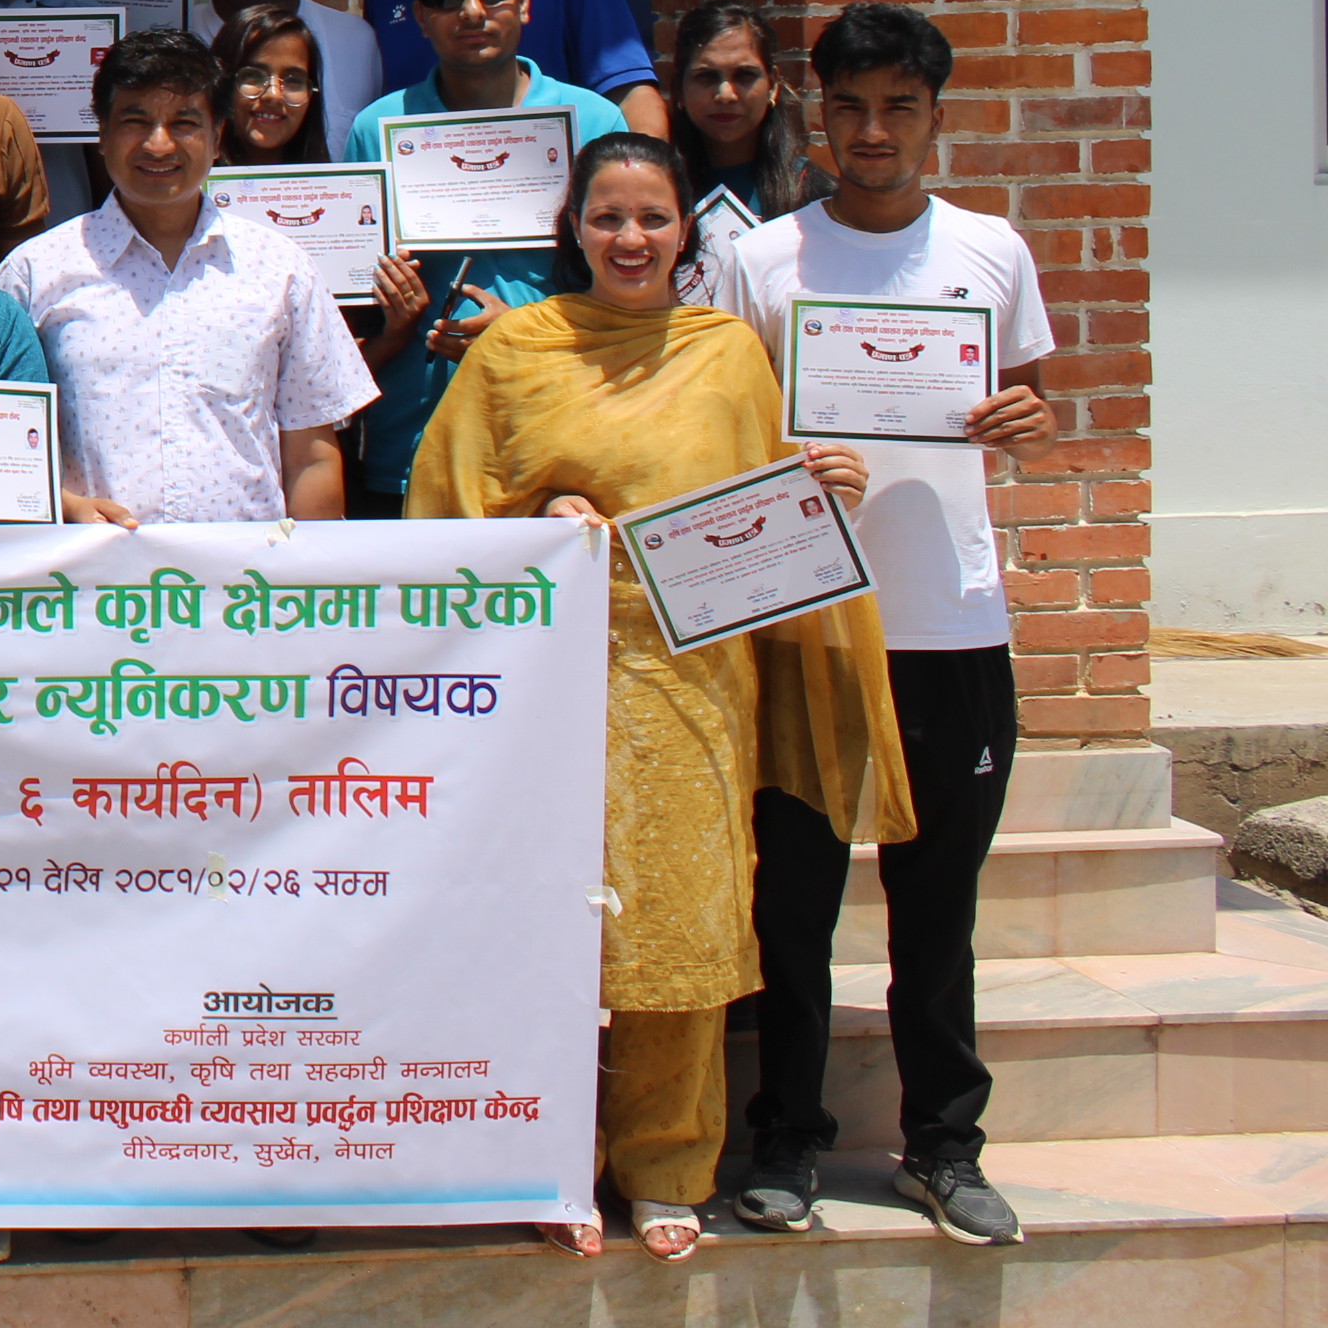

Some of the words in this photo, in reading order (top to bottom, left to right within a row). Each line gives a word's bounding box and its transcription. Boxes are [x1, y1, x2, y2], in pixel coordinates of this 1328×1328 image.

[95, 567, 205, 644] कृषि
[223, 569, 382, 635] क्षेत्रमा
[398, 566, 557, 629] पारेको
[326, 664, 502, 718] विषयक
[21, 778, 43, 826] ६
[72, 761, 261, 822] कार्यदिन)
[288, 757, 434, 818] तालिम
[43, 859, 103, 894] देखि
[115, 868, 300, 897] २०८१/०२/२६
[313, 870, 390, 896] सम्म
[204, 983, 335, 1013] आयोजक
[164, 1023, 230, 1046] कर्णाली
[241, 1024, 286, 1046] प्रदेश
[297, 1031, 361, 1046] सरकार
[30, 1056, 75, 1085] भूमि
[88, 1062, 174, 1083] व्यवस्था,
[190, 1056, 236, 1086] कृषि
[249, 1063, 291, 1080] तथा
[305, 1056, 387, 1082] सहकारी
[400, 1061, 490, 1079] मन्त्रालय
[33, 1099, 81, 1122] तथा
[201, 1101, 297, 1124] व्यवसाय
[385, 1092, 477, 1126] प्रशिक्षण
[485, 1090, 541, 1122] केन्द्र
[122, 1136, 238, 1162] वीरेन्द्रनगर,
[253, 1137, 319, 1167] सुर्खेत,
[335, 1137, 395, 1159] नेपाल
